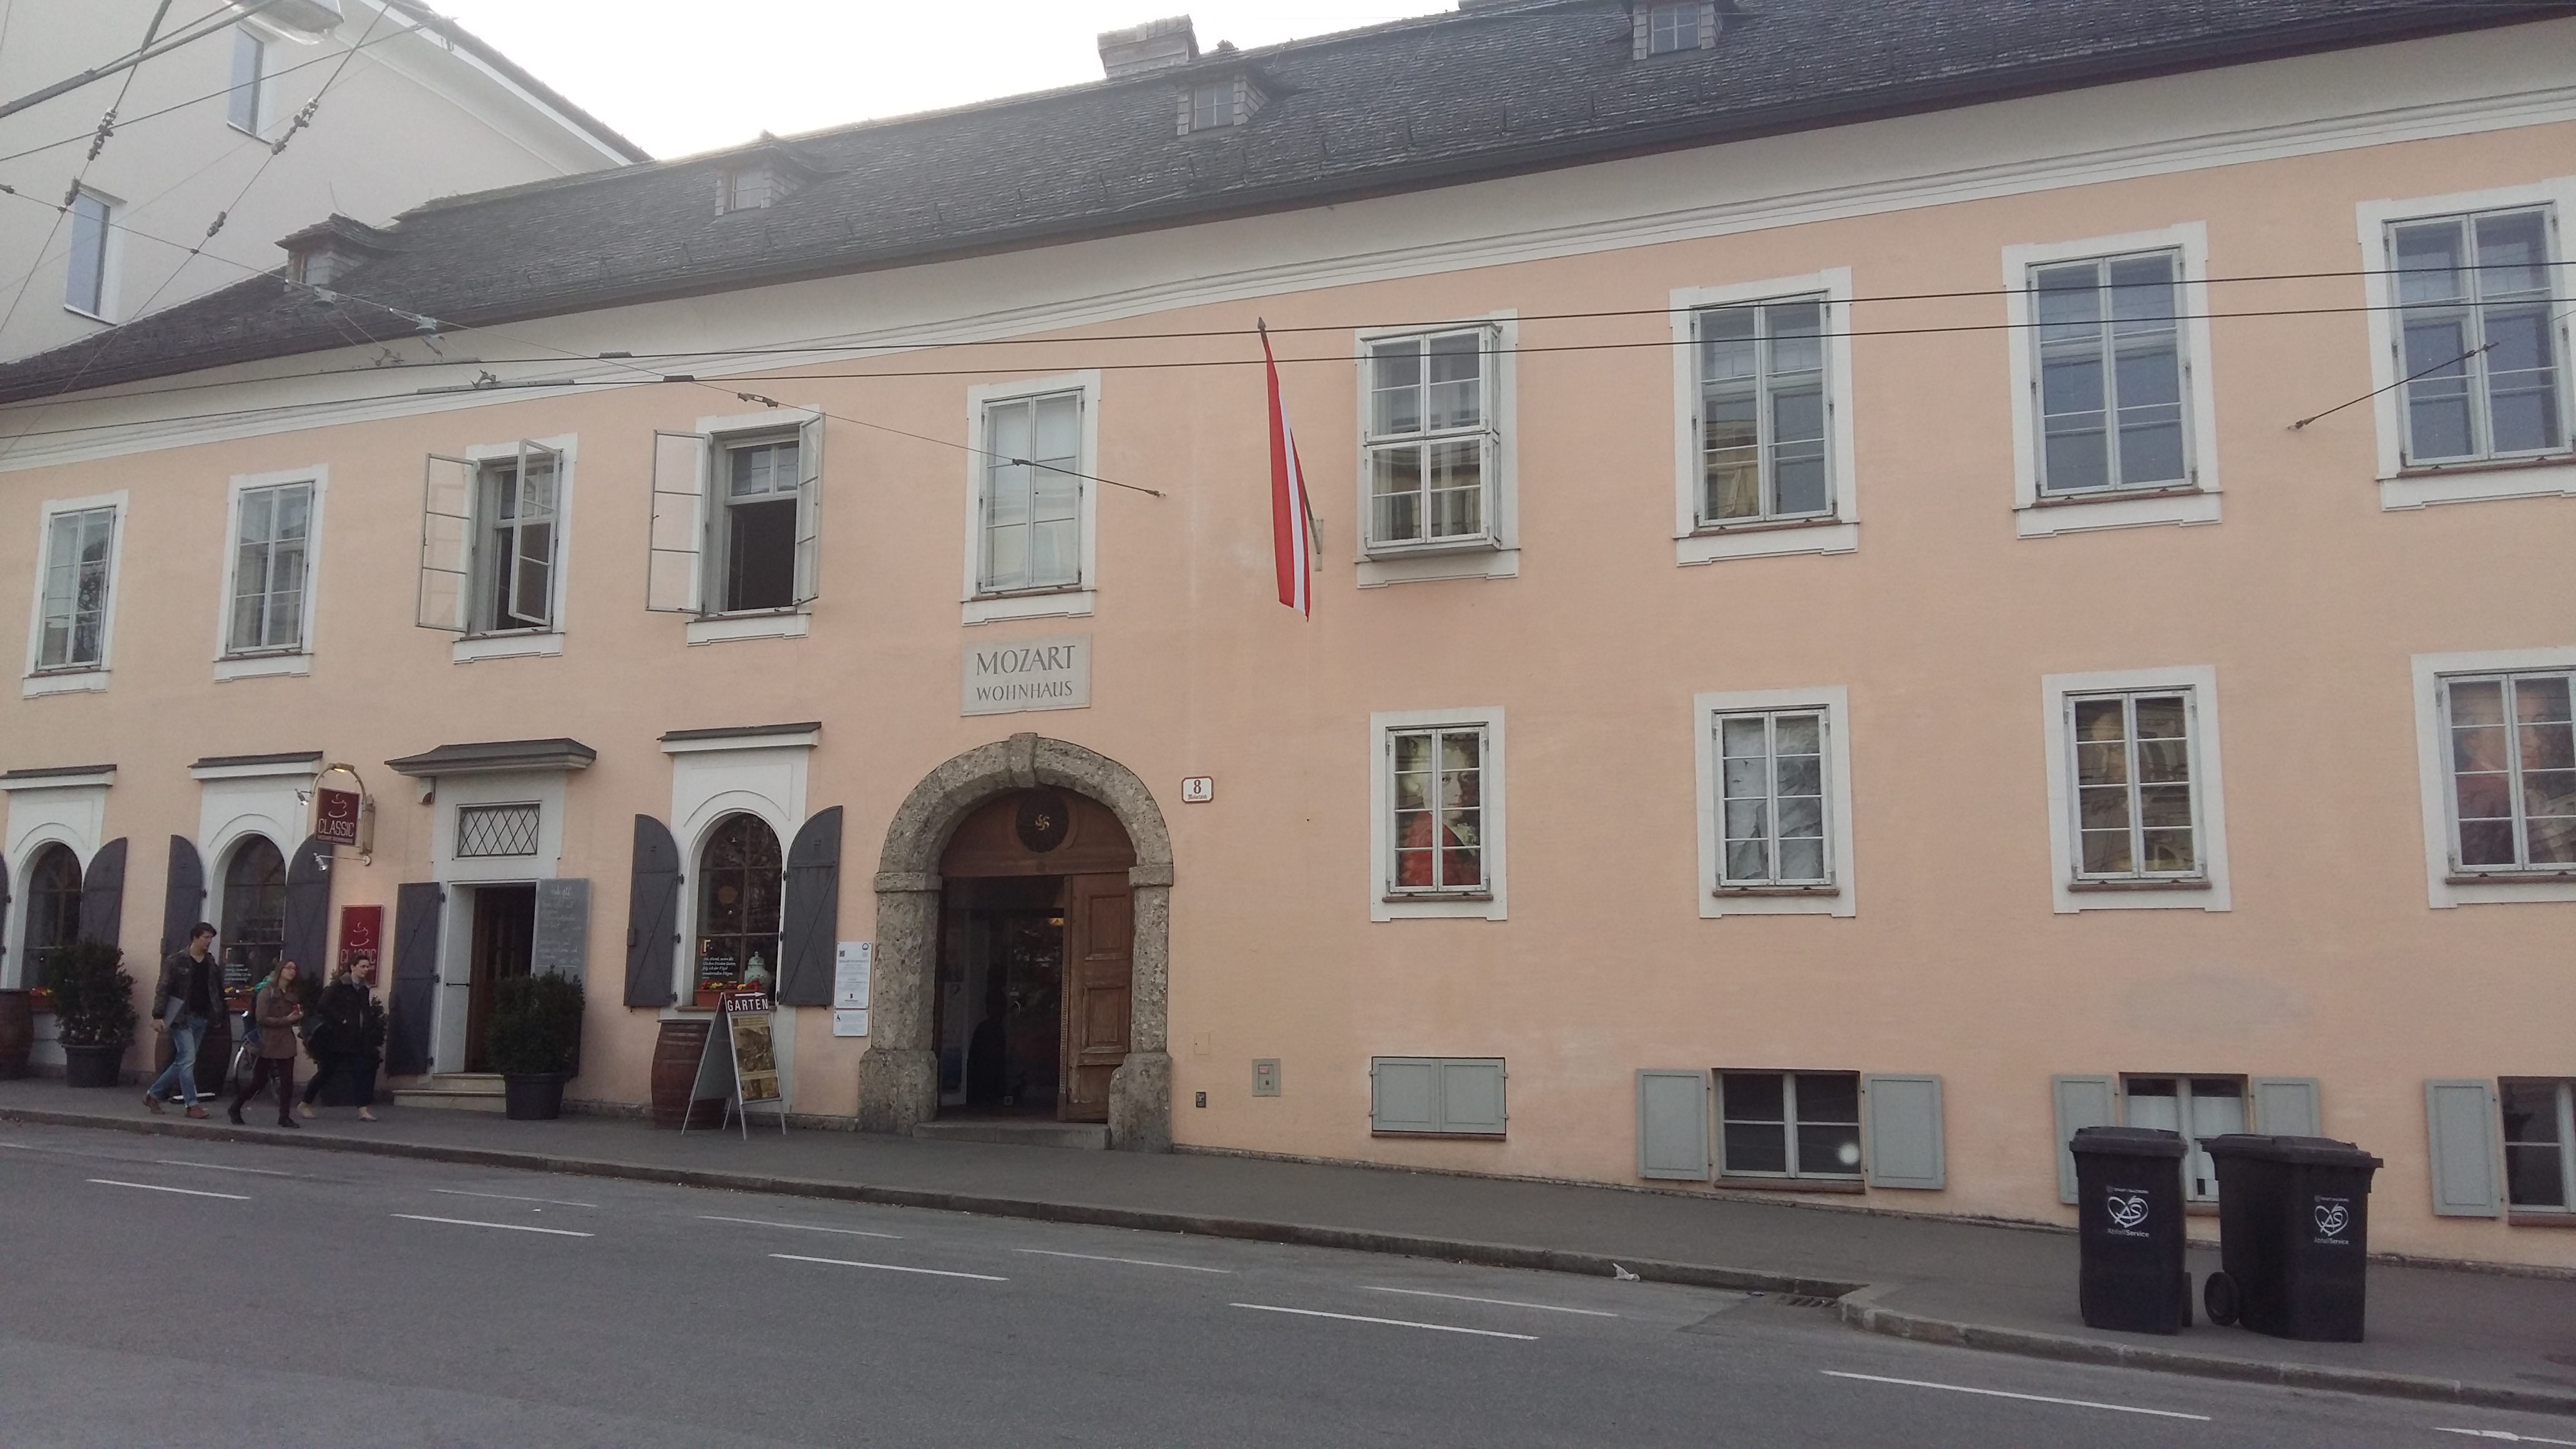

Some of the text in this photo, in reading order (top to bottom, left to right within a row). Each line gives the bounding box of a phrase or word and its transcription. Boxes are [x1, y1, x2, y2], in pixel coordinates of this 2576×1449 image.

[976, 645, 1076, 676] MOZART
[976, 681, 1073, 701] WOHNHAUS
[1193, 779, 1202, 794] 8
[318, 818, 354, 837] CLASSIC
[727, 998, 769, 1011] GARTEN
